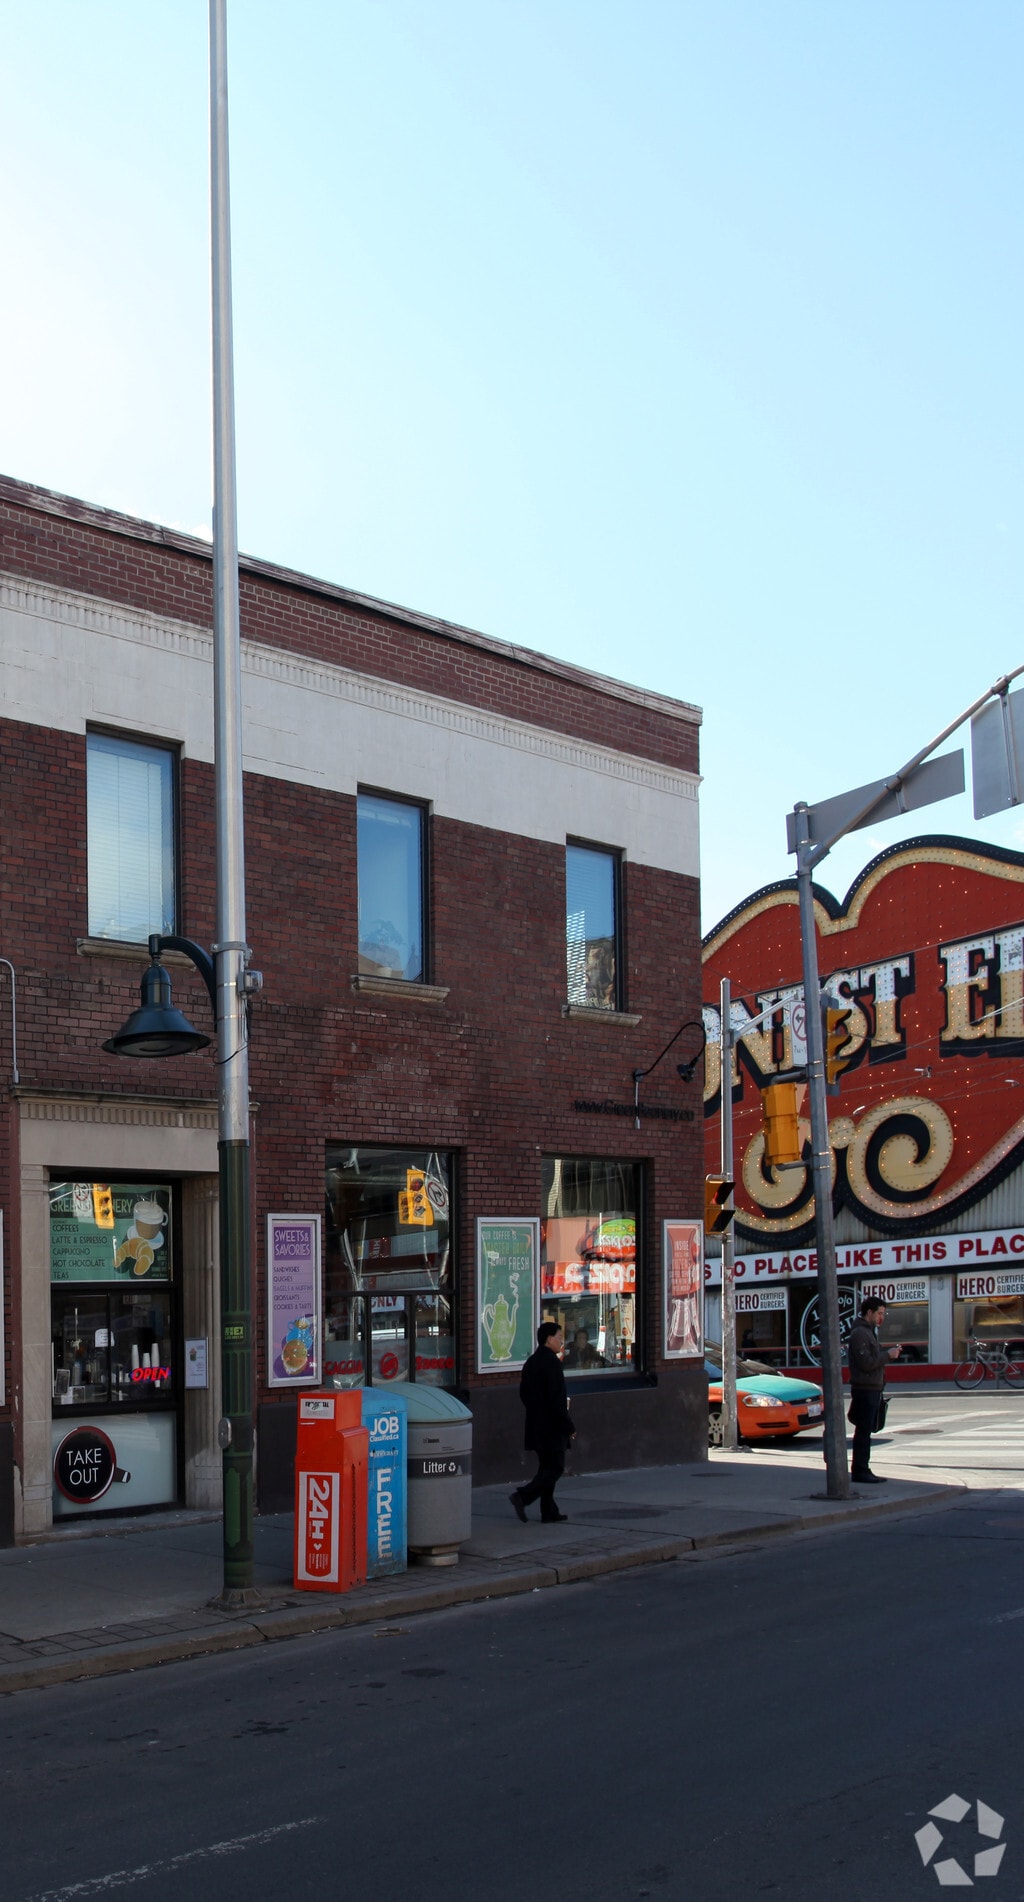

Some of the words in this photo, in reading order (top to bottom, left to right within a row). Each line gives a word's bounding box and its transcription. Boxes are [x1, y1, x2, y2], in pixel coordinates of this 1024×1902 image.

[52, 1236, 71, 1244] LATTE
[275, 1244, 311, 1256] SAVORIES
[68, 1259, 105, 1267] CHOCOLATE
[508, 1257, 530, 1270] FRESH
[754, 1254, 818, 1276] PLACE
[835, 1248, 883, 1269] LIKE
[891, 1242, 947, 1263] THIS
[863, 1283, 896, 1301] HERO
[896, 1281, 926, 1291] CERTIFIED
[959, 1276, 995, 1296] HERO
[760, 1292, 785, 1300] CERTIFIED
[896, 1290, 926, 1300] BURGERS
[760, 1300, 785, 1309] BURGERS
[131, 1366, 171, 1383] OPEN
[369, 1416, 399, 1436] JOB
[66, 1448, 102, 1466] TAKE
[423, 1461, 447, 1474] Litter
[69, 1467, 99, 1486] OUT
[377, 1468, 393, 1559] FREE
